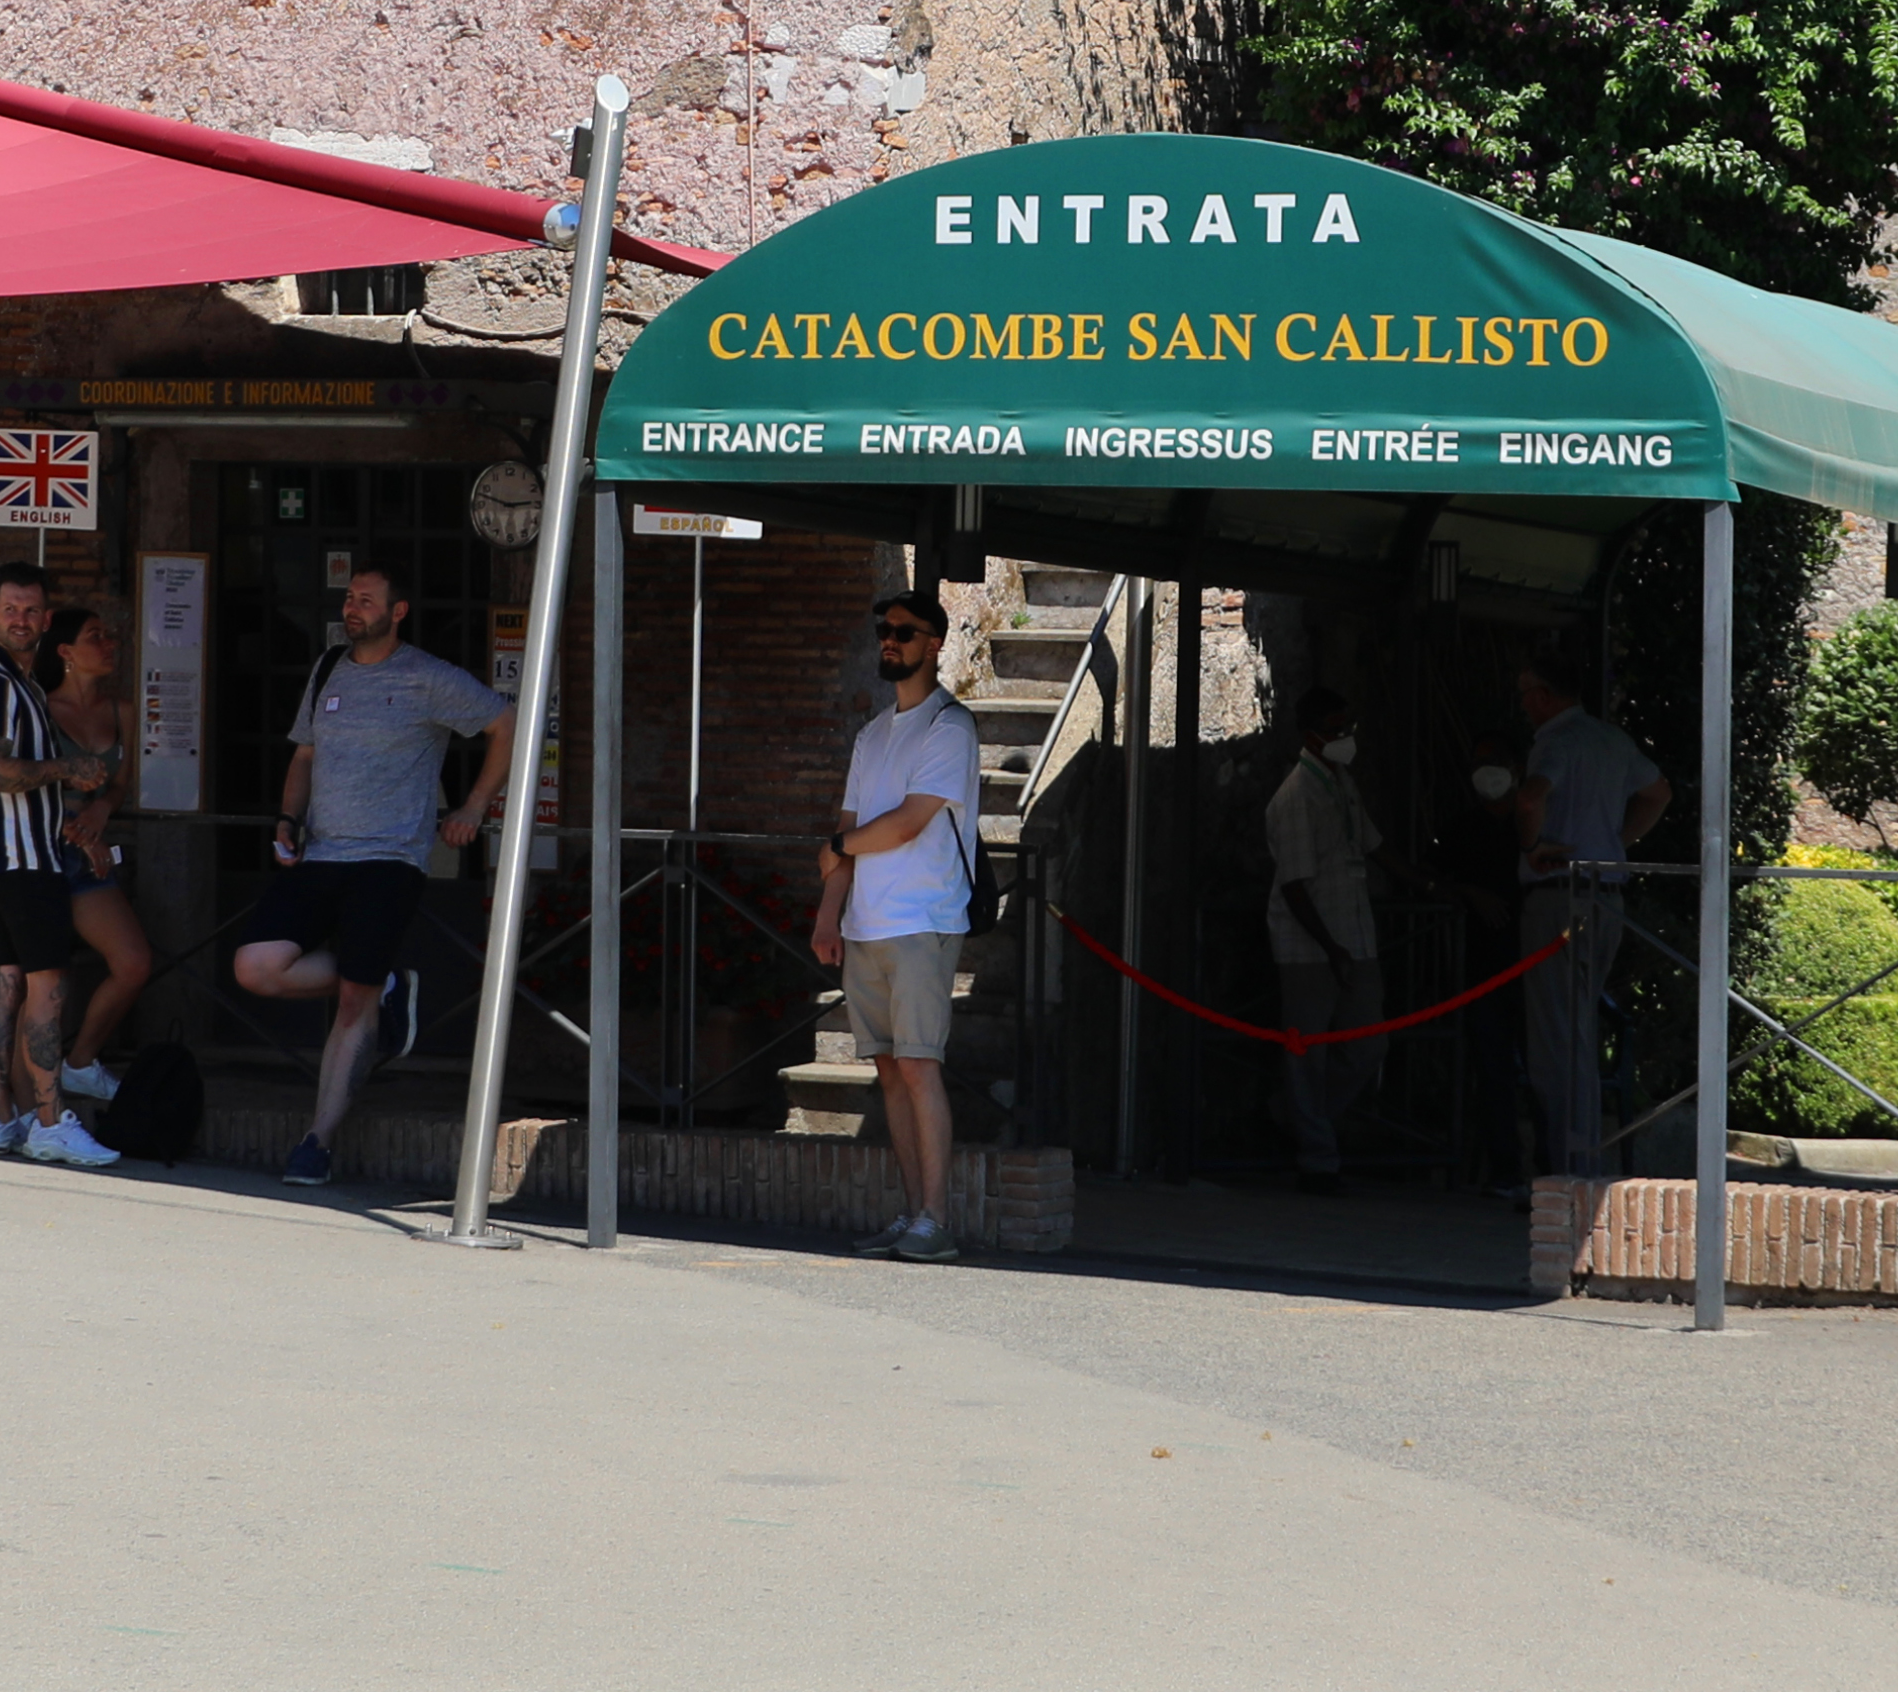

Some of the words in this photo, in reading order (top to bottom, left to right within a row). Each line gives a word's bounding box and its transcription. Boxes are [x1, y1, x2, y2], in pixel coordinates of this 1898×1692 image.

[935, 193, 1361, 245] ENTRATA
[708, 312, 1105, 361] CATACOMBE
[1128, 312, 1258, 362] SAN
[1275, 312, 1609, 368] CALLISTO
[79, 380, 215, 405] COORDINAZIONE
[224, 382, 234, 405] E
[242, 381, 376, 405] INFORMAZIONE
[642, 421, 825, 455] ENTRANCE
[860, 423, 1027, 457] ENTRADA
[1065, 425, 1273, 461] INGRESSUS
[1311, 422, 1460, 464] ENTRÉE
[1498, 432, 1673, 468] EINGANG
[10, 510, 71, 525] ENGLISH
[660, 516, 734, 532] ESPAÑOL
[496, 614, 524, 628] NEXT
[495, 660, 518, 679] 15
